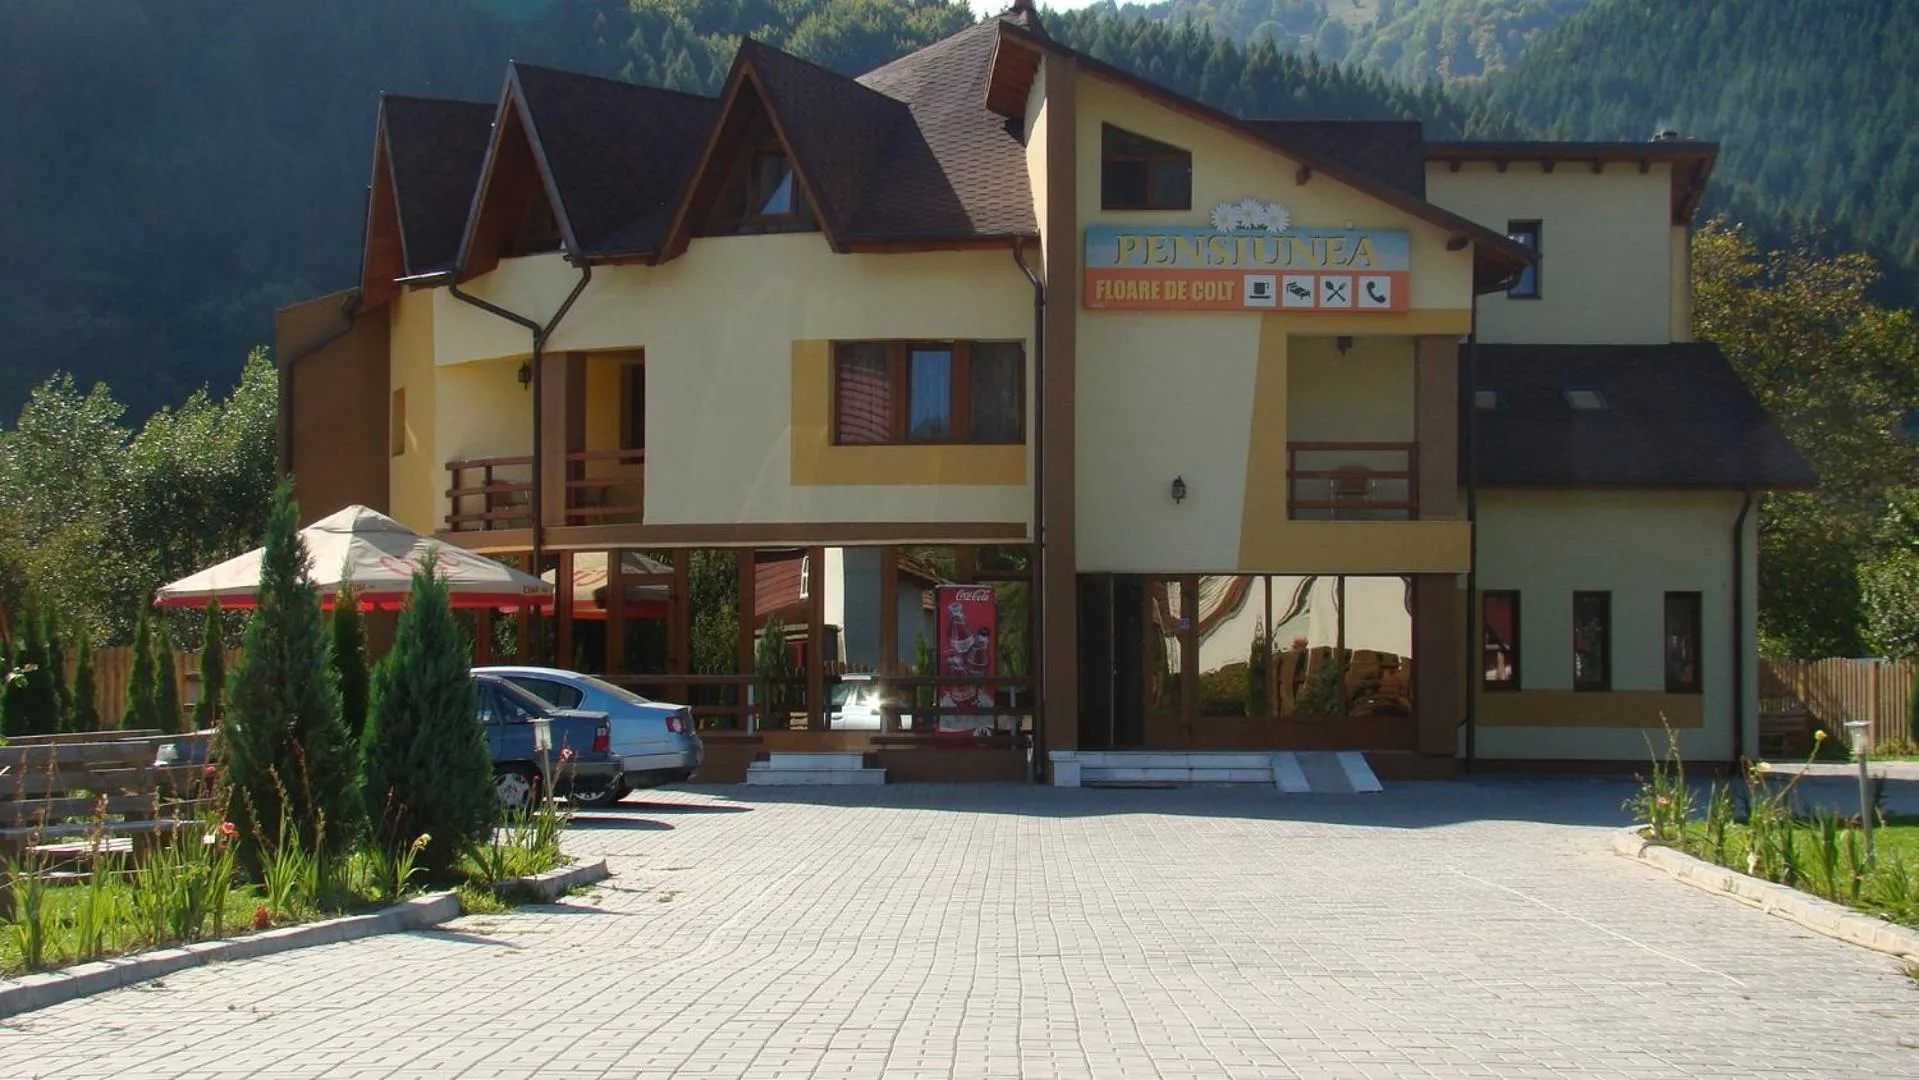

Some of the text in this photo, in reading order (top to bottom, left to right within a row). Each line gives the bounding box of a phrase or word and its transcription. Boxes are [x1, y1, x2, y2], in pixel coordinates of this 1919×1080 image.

[1114, 233, 1377, 267] PENSIUNEA
[1095, 279, 1160, 301] FLOARE
[1164, 280, 1187, 301] DE
